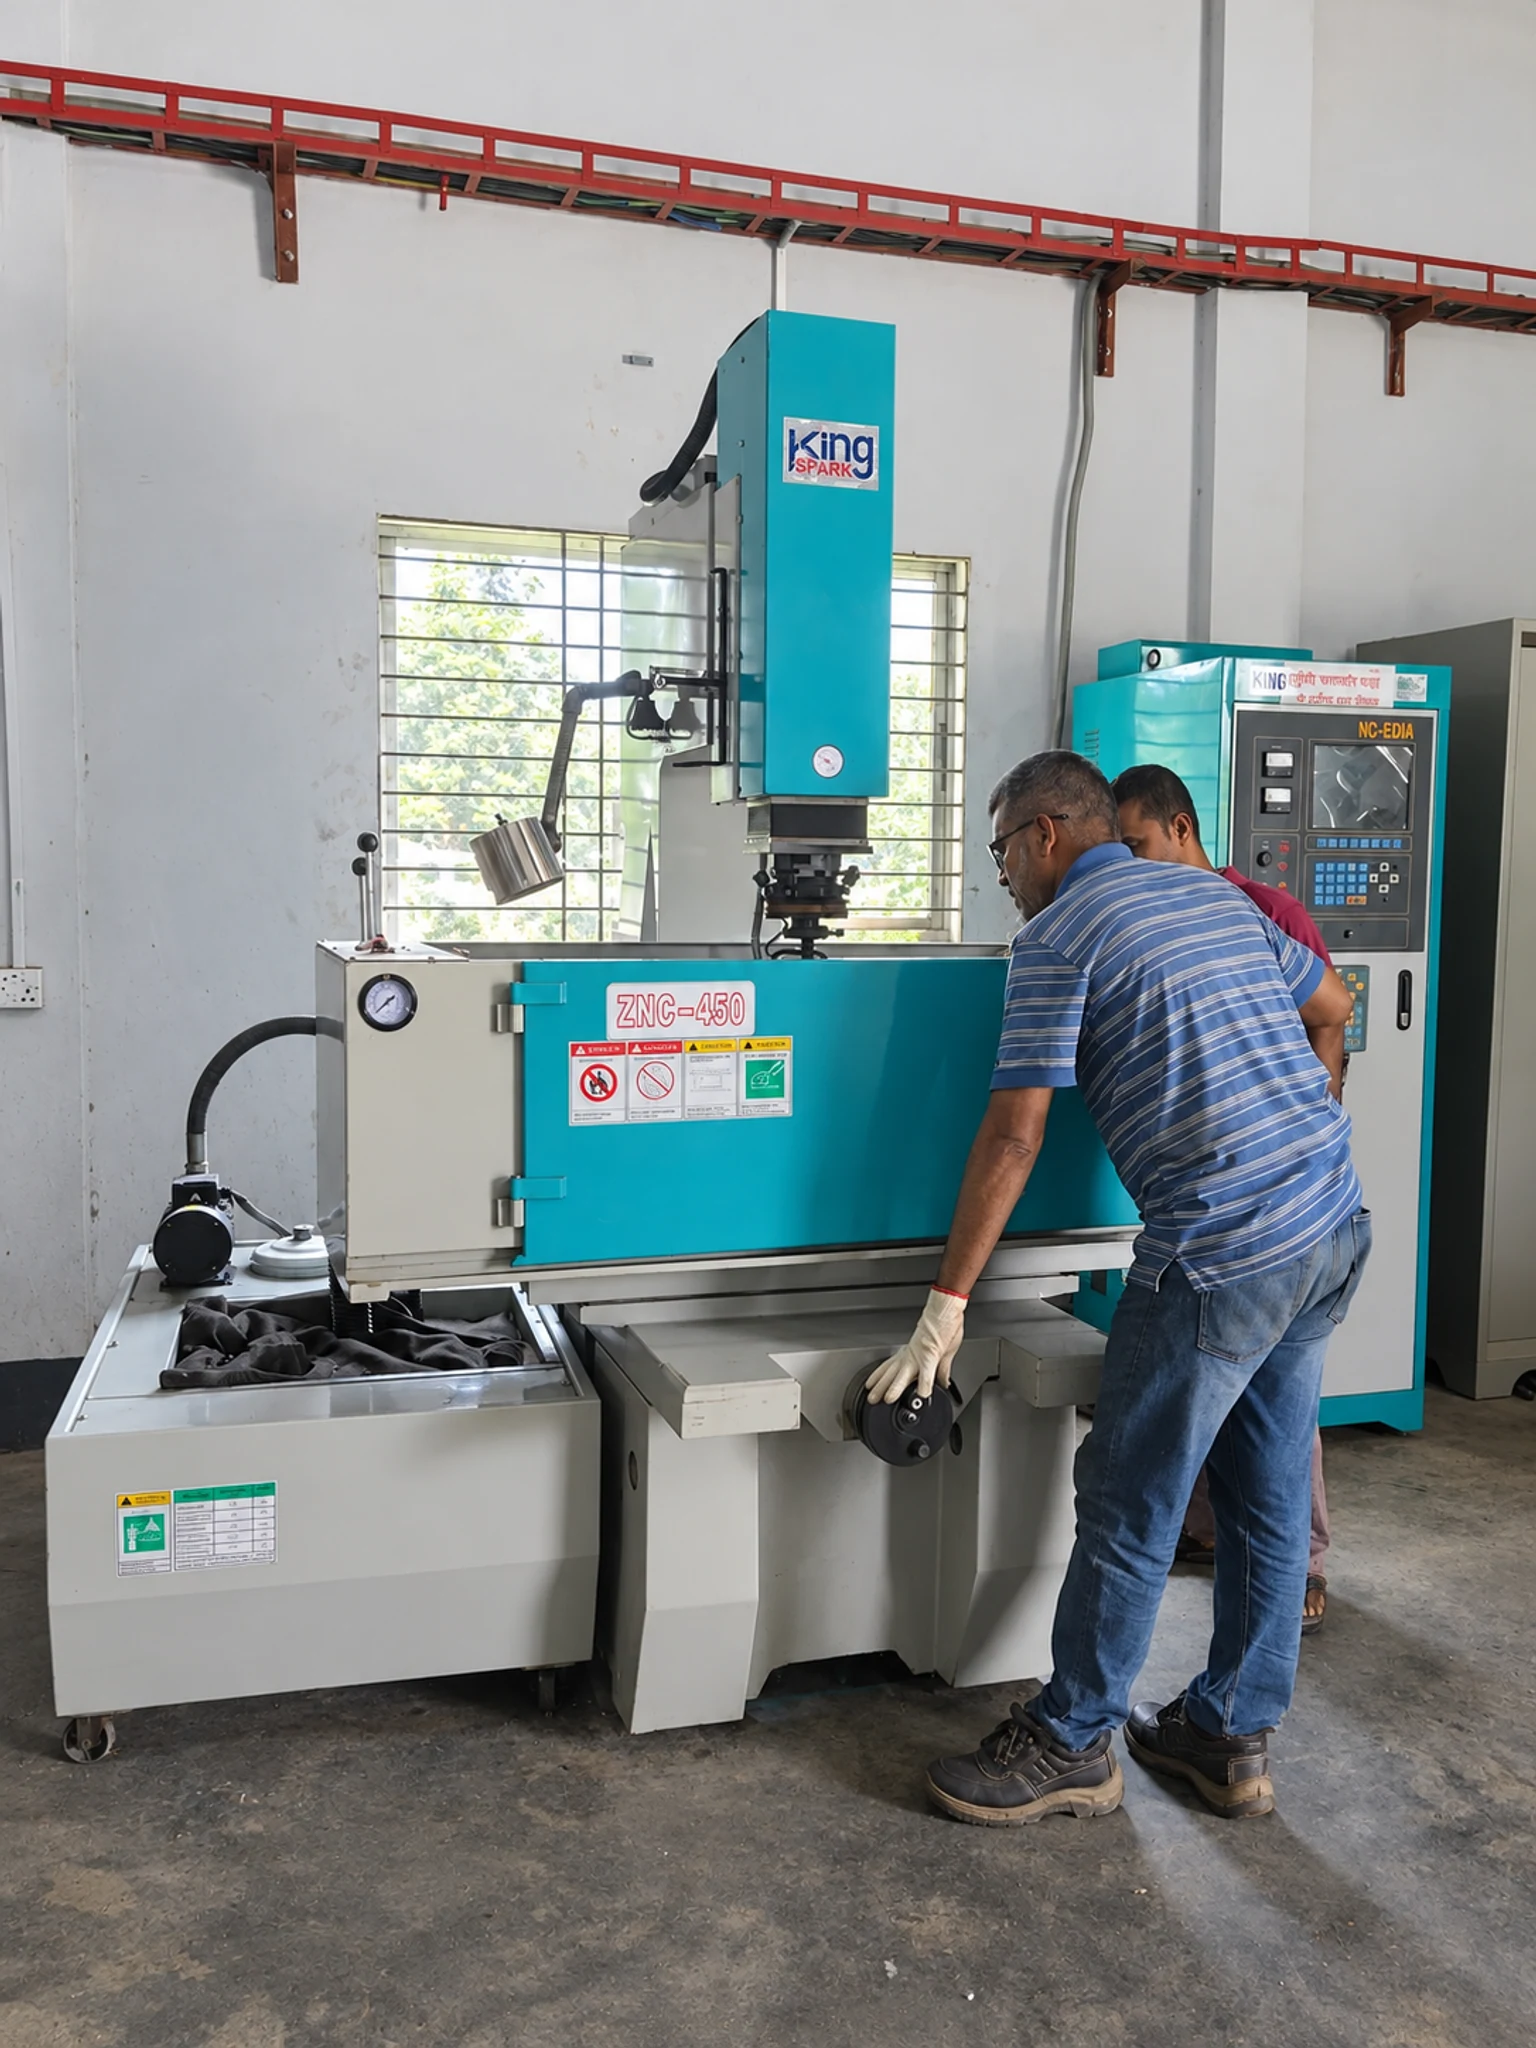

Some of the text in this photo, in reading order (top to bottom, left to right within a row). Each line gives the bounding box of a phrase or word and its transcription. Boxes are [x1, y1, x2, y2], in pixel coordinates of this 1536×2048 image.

[789, 428, 874, 480] King
[795, 458, 853, 478] SPARK
[1252, 671, 1287, 690] KING
[1358, 721, 1414, 740] NC-EDIA
[616, 991, 746, 1029] ZNC-450
